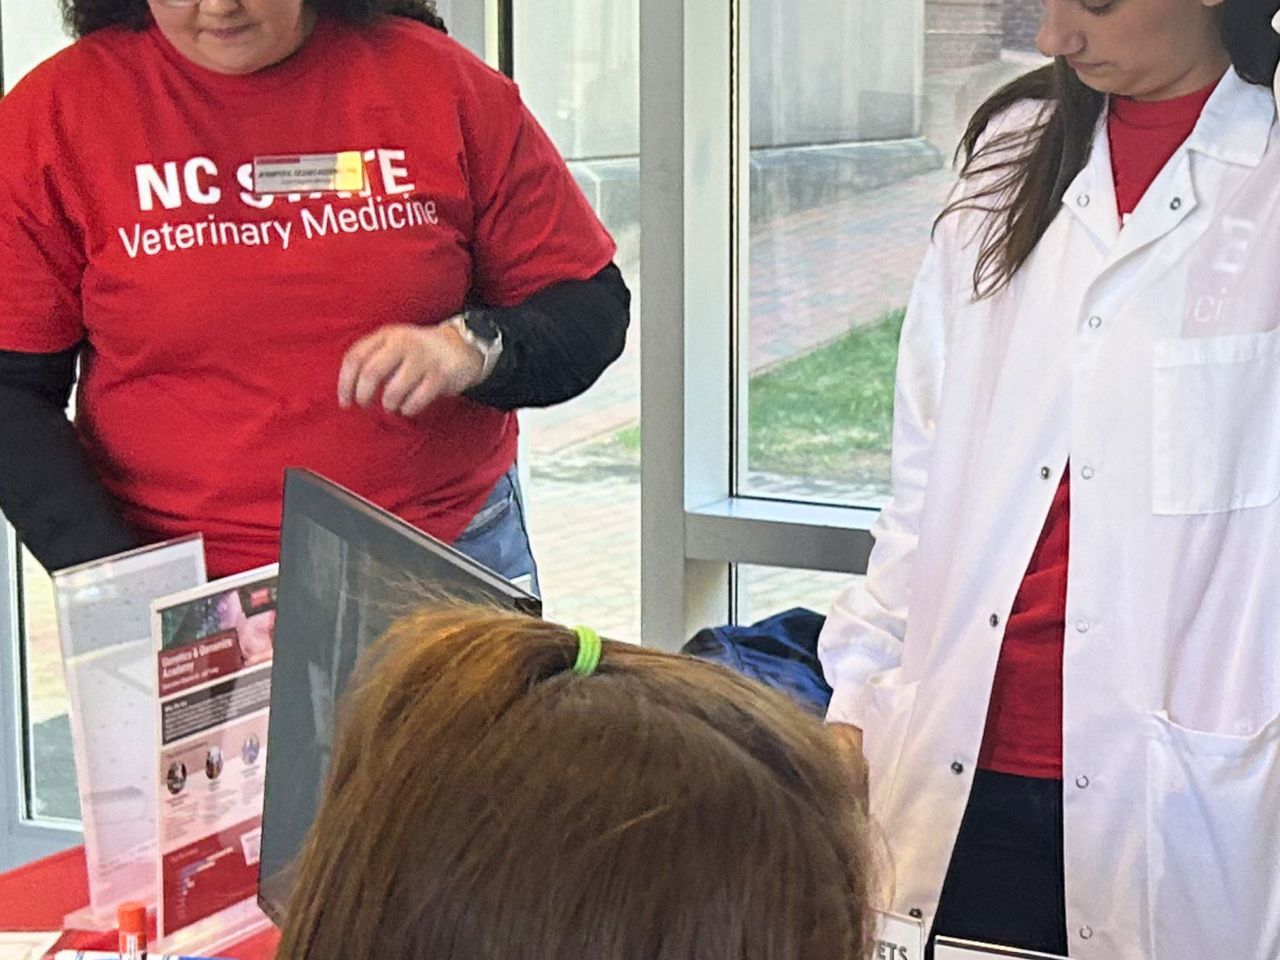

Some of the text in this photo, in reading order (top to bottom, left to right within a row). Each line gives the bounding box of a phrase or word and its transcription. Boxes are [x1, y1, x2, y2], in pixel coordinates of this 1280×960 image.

[134, 155, 221, 211] NC
[118, 195, 438, 259] Veterinary Medicine
